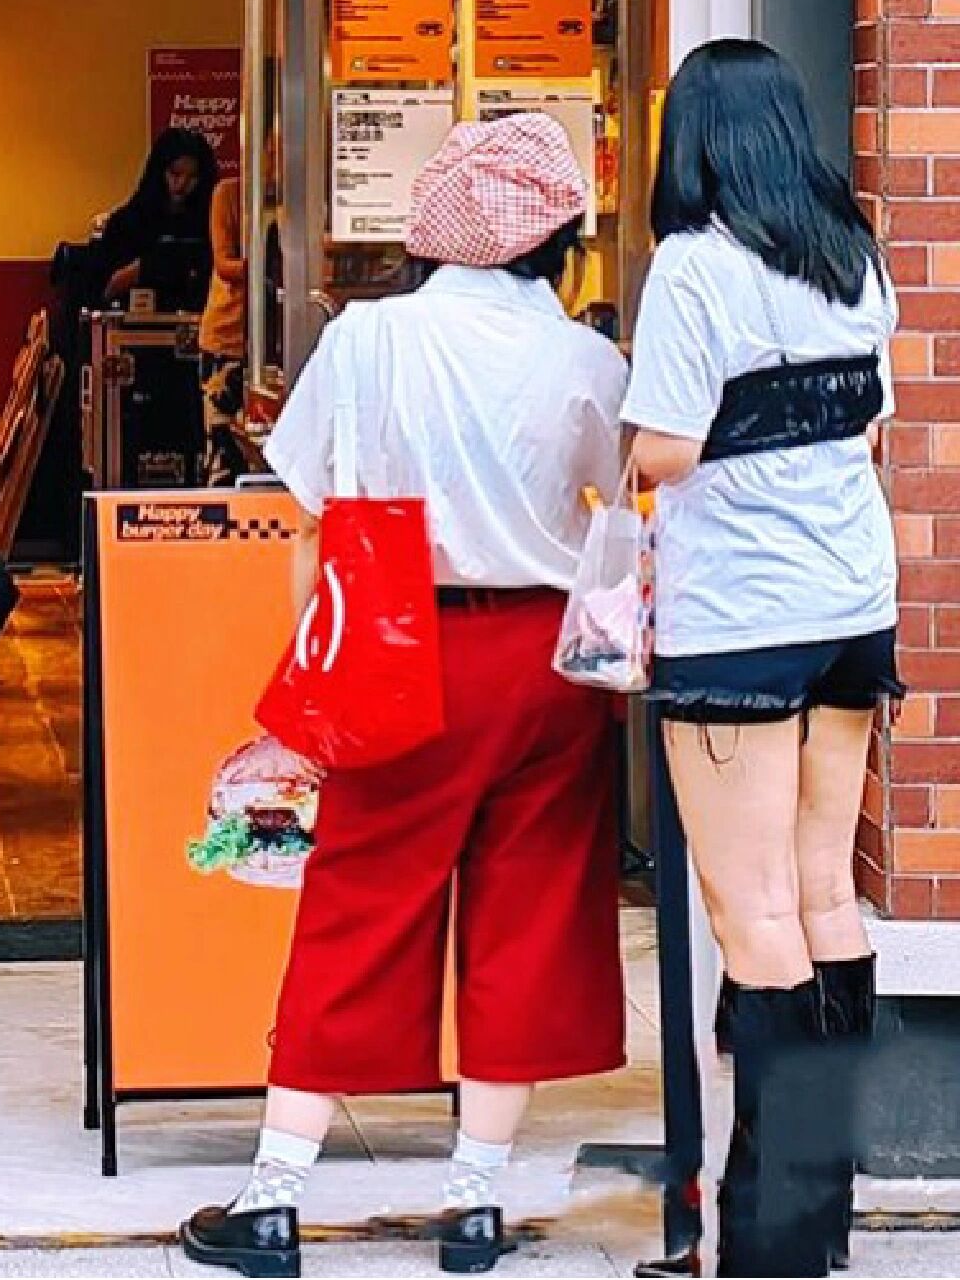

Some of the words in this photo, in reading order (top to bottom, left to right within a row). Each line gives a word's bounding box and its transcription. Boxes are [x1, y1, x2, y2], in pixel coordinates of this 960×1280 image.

[173, 94, 238, 114] Happy
[139, 504, 202, 523] Happy
[122, 519, 185, 541] burger
[187, 520, 225, 541] day
